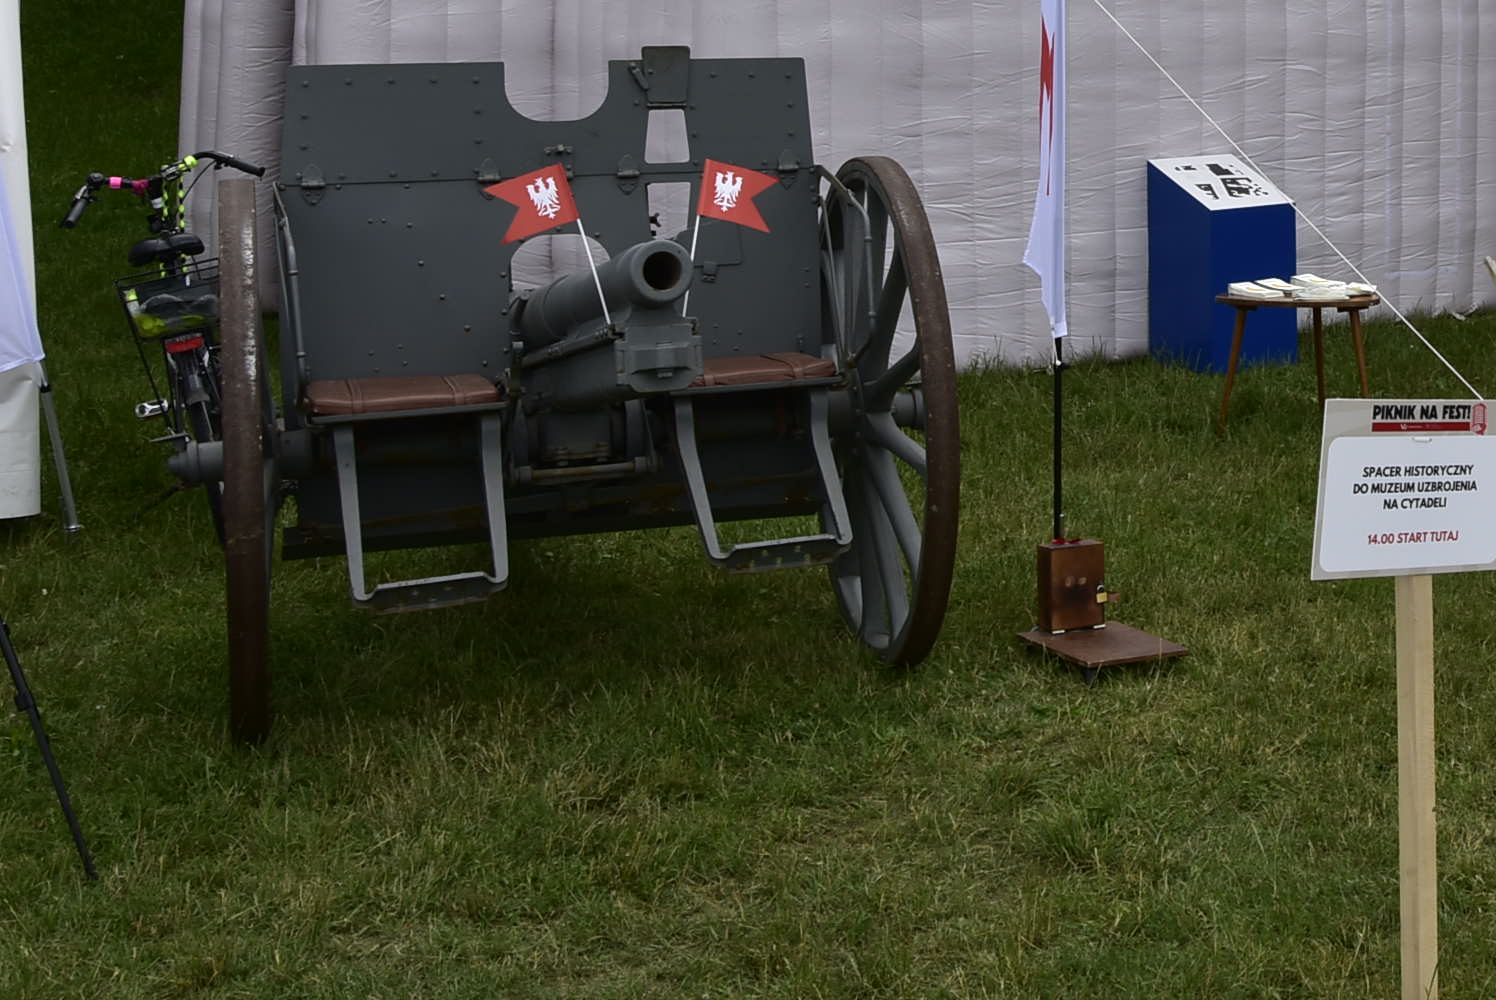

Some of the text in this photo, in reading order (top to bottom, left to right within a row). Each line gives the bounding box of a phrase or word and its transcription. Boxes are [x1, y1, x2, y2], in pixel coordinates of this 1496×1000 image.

[1372, 405, 1471, 420] PIKNIK NA FEST!
[1362, 465, 1474, 478] SPACER HISTORYCZNY
[1353, 481, 1477, 494] DO MUZEUM UZBROJENIA
[1383, 497, 1447, 510] NA CYTADELI
[1367, 530, 1459, 545] 14.00 START TUTAJ
